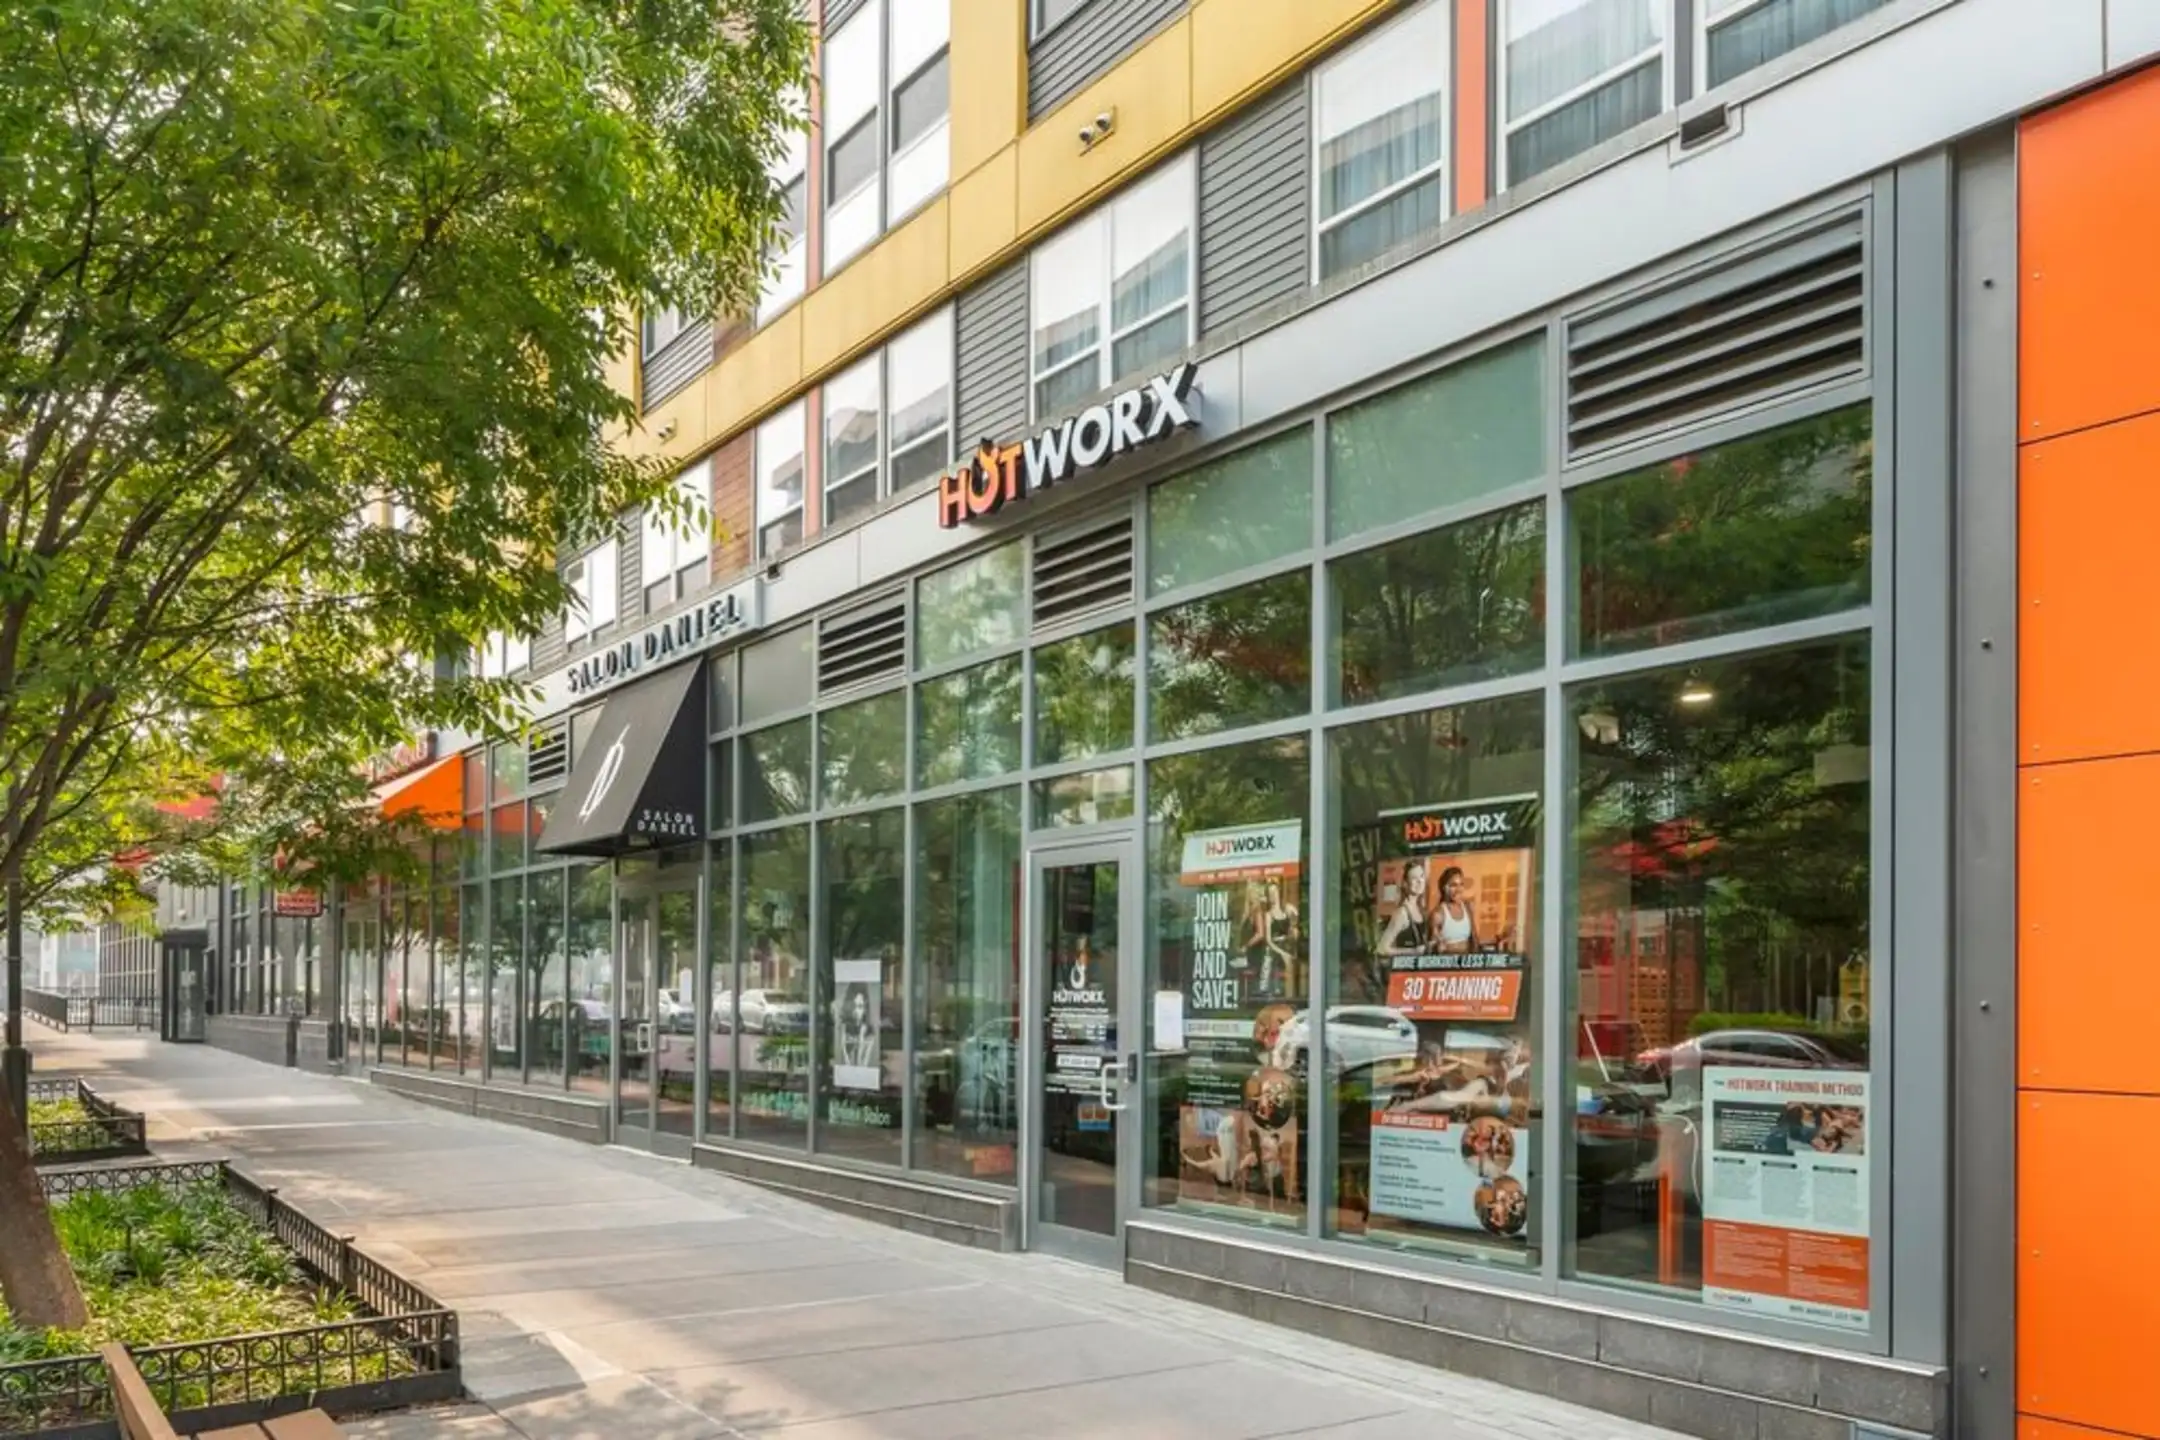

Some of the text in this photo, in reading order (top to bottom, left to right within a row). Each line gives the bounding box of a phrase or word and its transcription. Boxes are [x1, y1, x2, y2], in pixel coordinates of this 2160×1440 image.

[939, 362, 1197, 528] HOTWORX
[567, 593, 742, 693] SALON DANIEL
[637, 820, 698, 836] DANIEL
[643, 809, 694, 824] SALON
[1405, 812, 1508, 841] HOTWORX
[1206, 834, 1276, 856] HOTWORX
[1194, 891, 1229, 921] JOIN
[1193, 920, 1231, 950] NOW
[1192, 951, 1227, 980] AND
[1052, 987, 1106, 1004] HOTWORX
[1192, 980, 1240, 1010] SAVE!
[1427, 975, 1503, 1001] TRAINING
[1727, 1078, 1773, 1091] HOTWORX
[1774, 1080, 1820, 1094] TRAINING
[1822, 1082, 1864, 1097] METHOD
